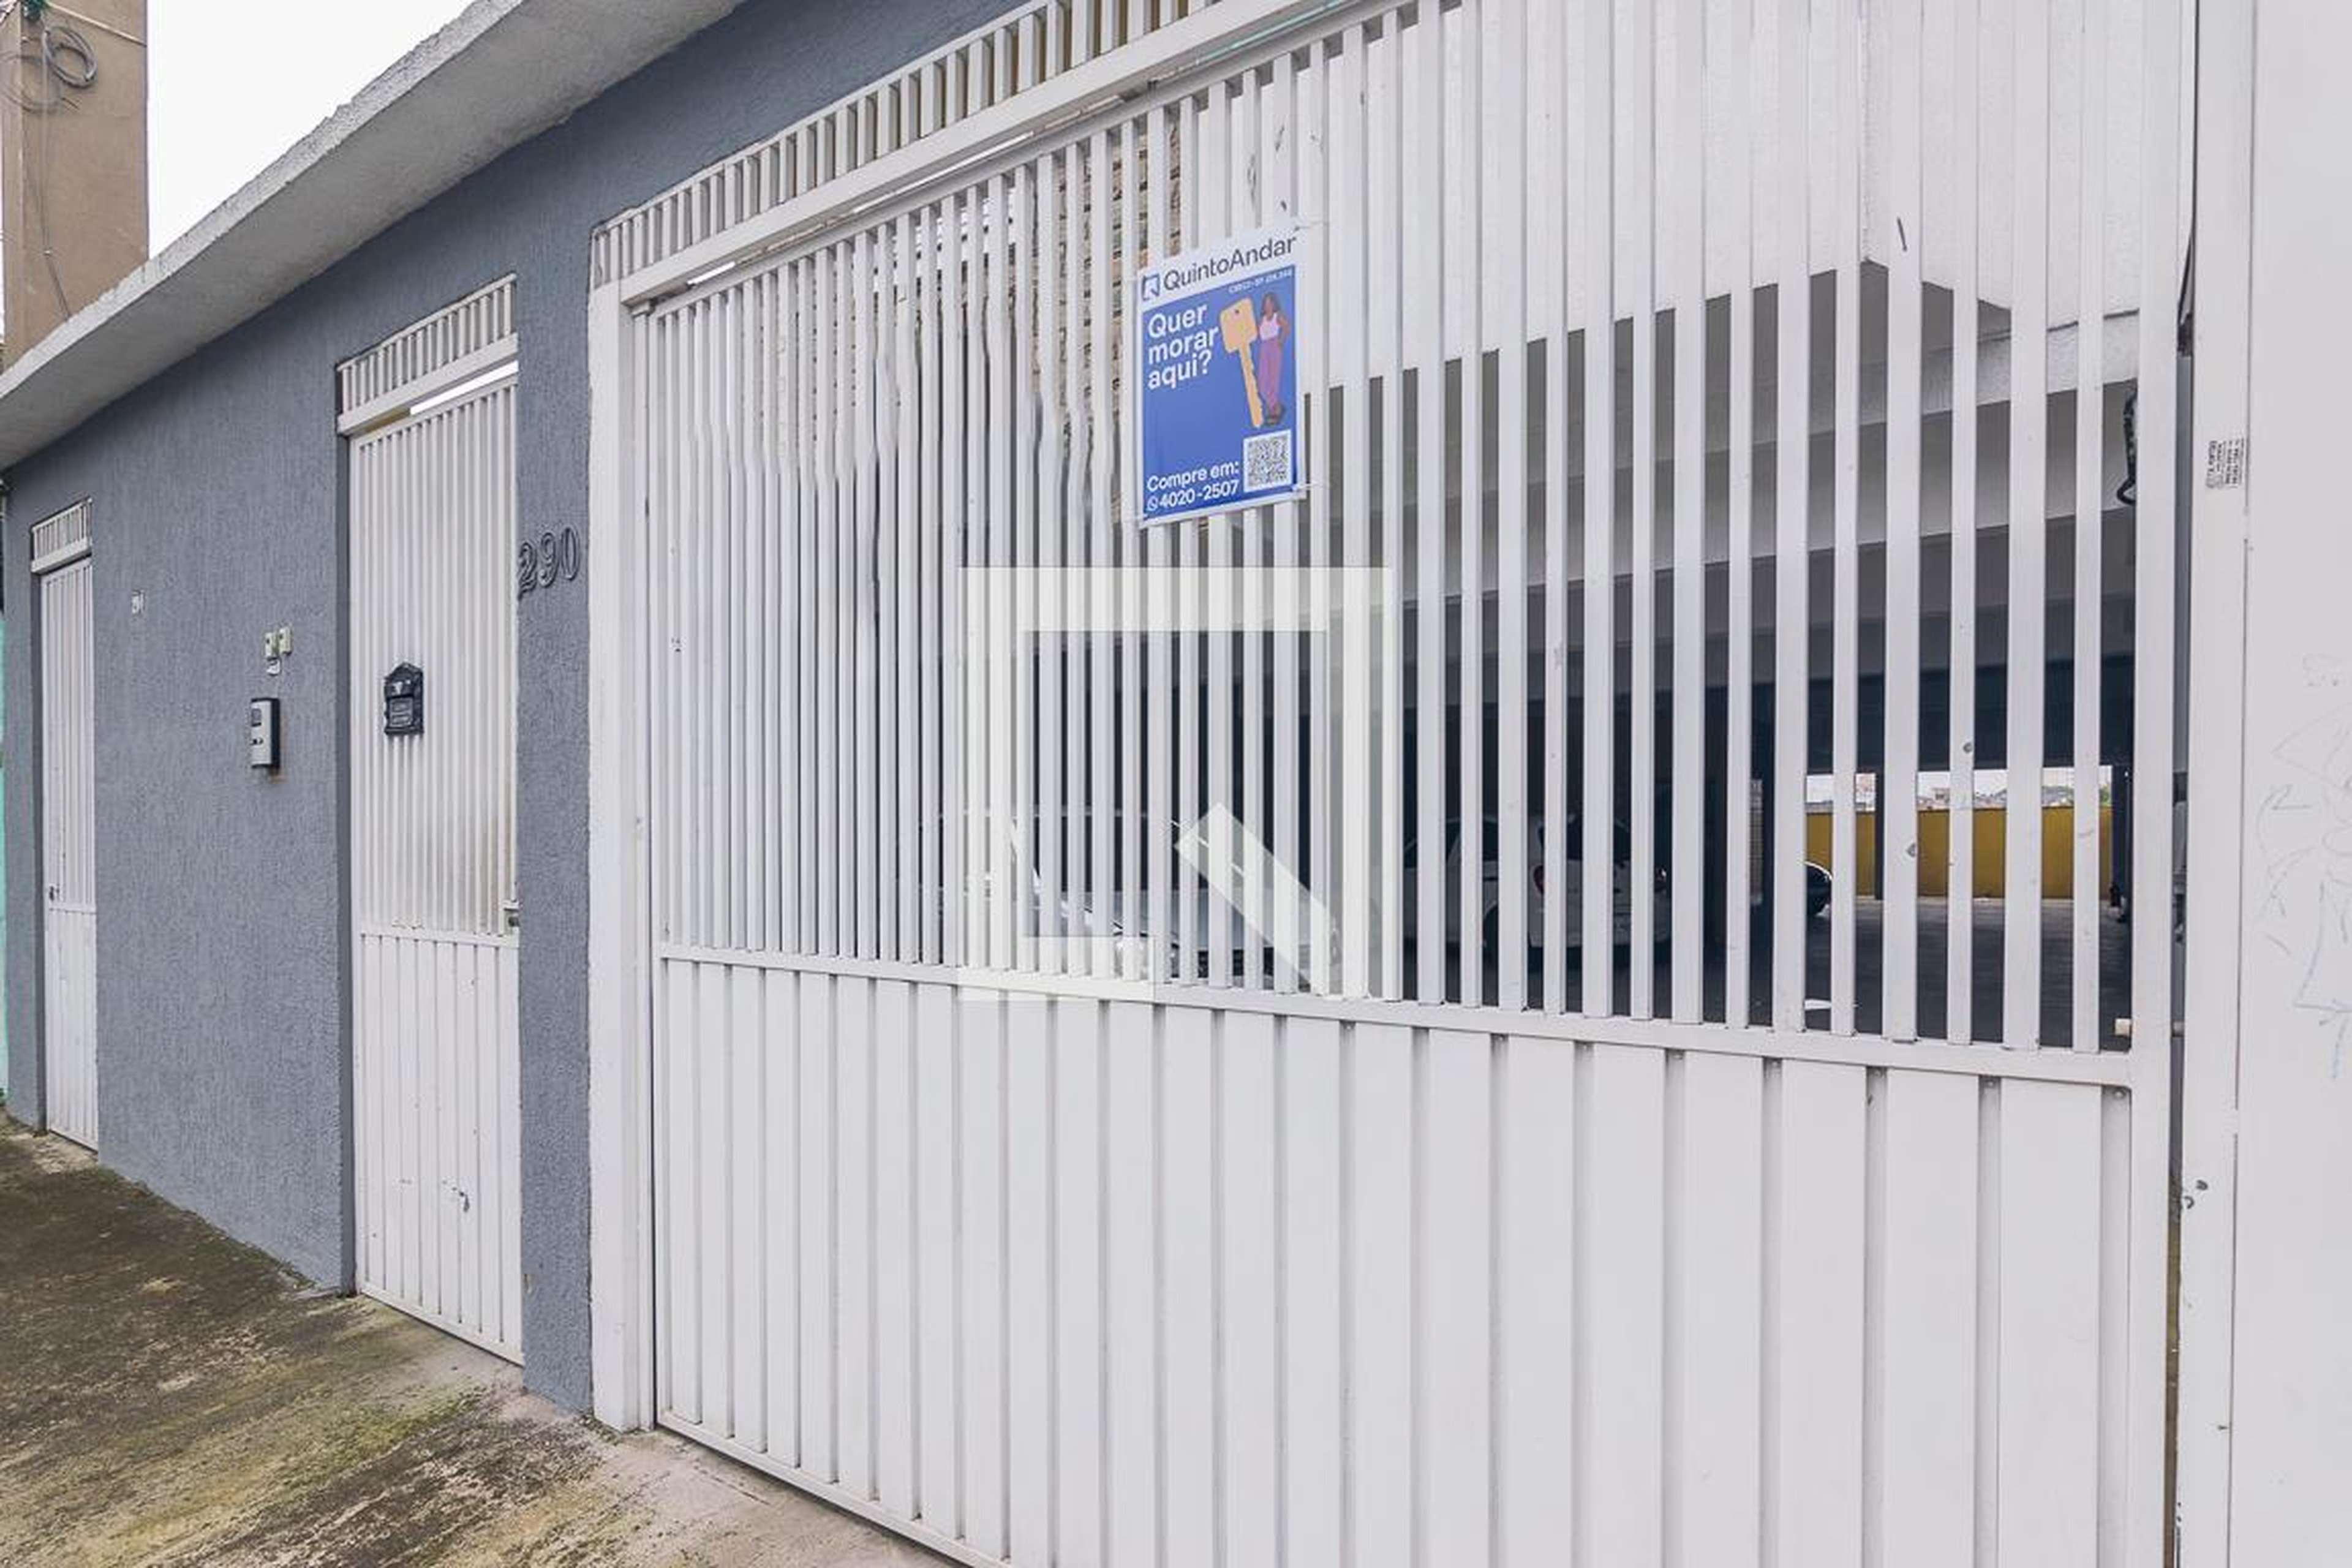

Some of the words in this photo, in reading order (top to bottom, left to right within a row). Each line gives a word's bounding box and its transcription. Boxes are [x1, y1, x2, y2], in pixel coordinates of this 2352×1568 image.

[1163, 236, 1297, 291] QuintoAndar
[1148, 304, 1207, 338] Quer
[1148, 326, 1219, 364] morar
[1148, 349, 1212, 390] aqui?
[1147, 468, 1207, 492] Compre
[1210, 461, 1239, 479] em:
[1159, 480, 1239, 508] 4020-2507
[518, 524, 581, 601] 290
